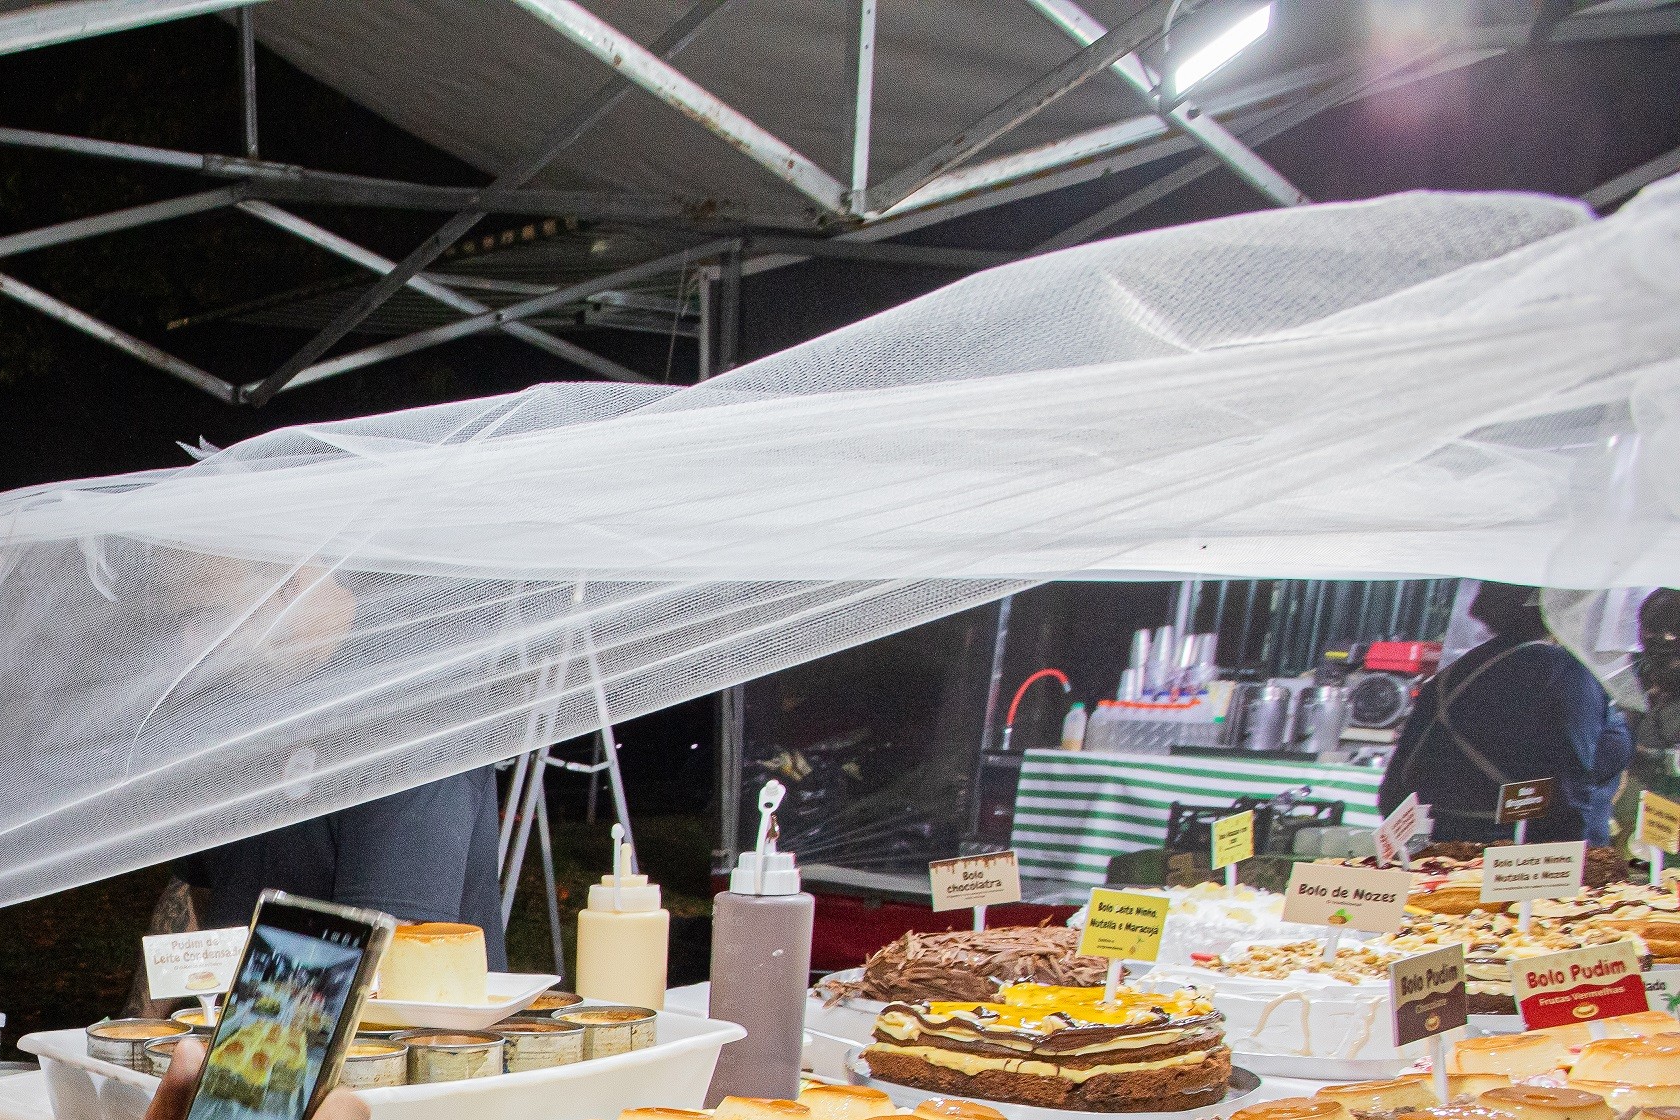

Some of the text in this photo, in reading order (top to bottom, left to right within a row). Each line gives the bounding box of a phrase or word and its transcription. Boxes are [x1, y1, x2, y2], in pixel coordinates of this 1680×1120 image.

[962, 870, 984, 881] Bolo
[1298, 883, 1397, 904] Bolo de Nozes
[1098, 901, 1113, 913] Bolo
[1089, 918, 1117, 930] Nutella
[171, 937, 220, 951] Pudim de
[153, 953, 181, 965] Leite
[1401, 964, 1458, 996] Bolo Pudim
[1526, 959, 1626, 989] Bolo Pudim
[1539, 986, 1625, 1006] Frutas Vermelhas
